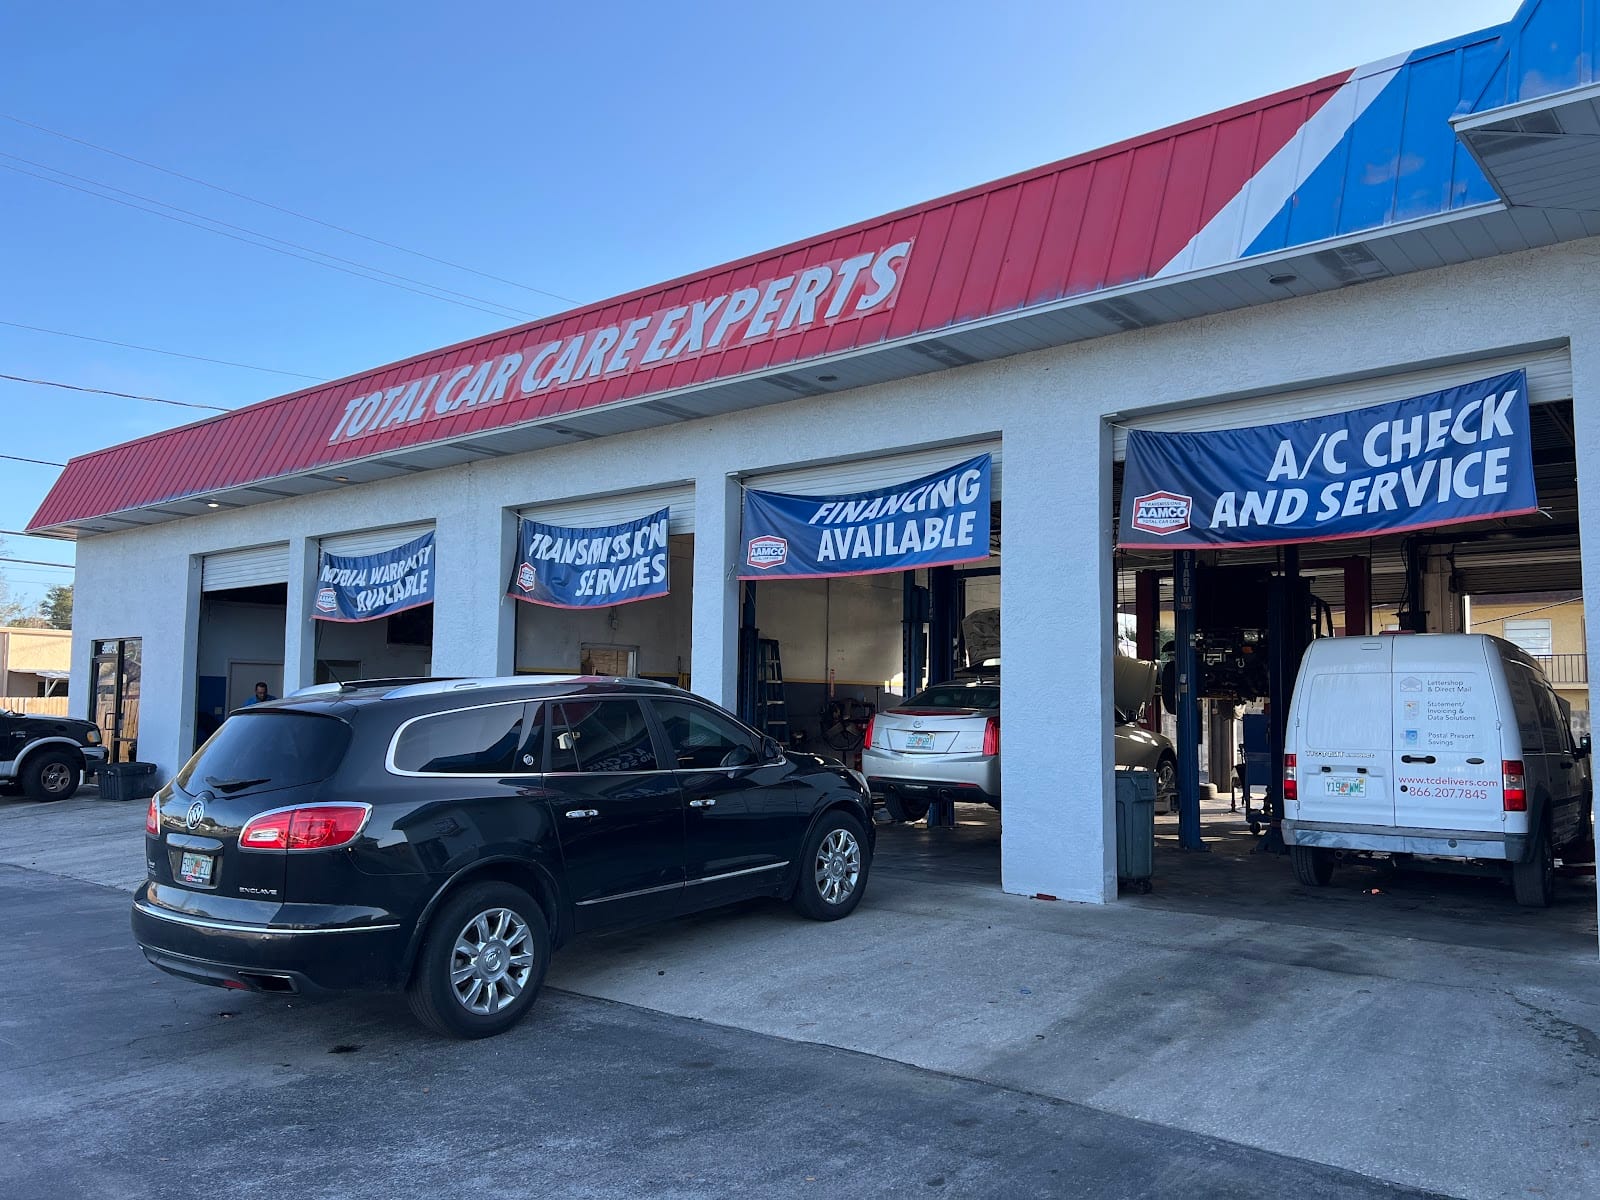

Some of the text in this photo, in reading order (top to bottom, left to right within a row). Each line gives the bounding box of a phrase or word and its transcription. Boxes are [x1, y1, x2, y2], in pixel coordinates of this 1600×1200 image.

[329, 241, 911, 441] TOTAL CAR CARE EXPERTS
[1266, 389, 1520, 482] A/C CHECK
[1209, 447, 1510, 528] AND SERVICE
[808, 469, 981, 524] FINANCING
[1136, 507, 1188, 518] AAMCO
[816, 510, 977, 562] AVAILABLE
[751, 547, 785, 556] AAMCO
[1427, 679, 1464, 687] Lettershop
[1398, 776, 1498, 787] www.tcdelivers.com
[1409, 786, 1487, 799] 866.207.7845
[239, 886, 278, 895] ENCLAVE
